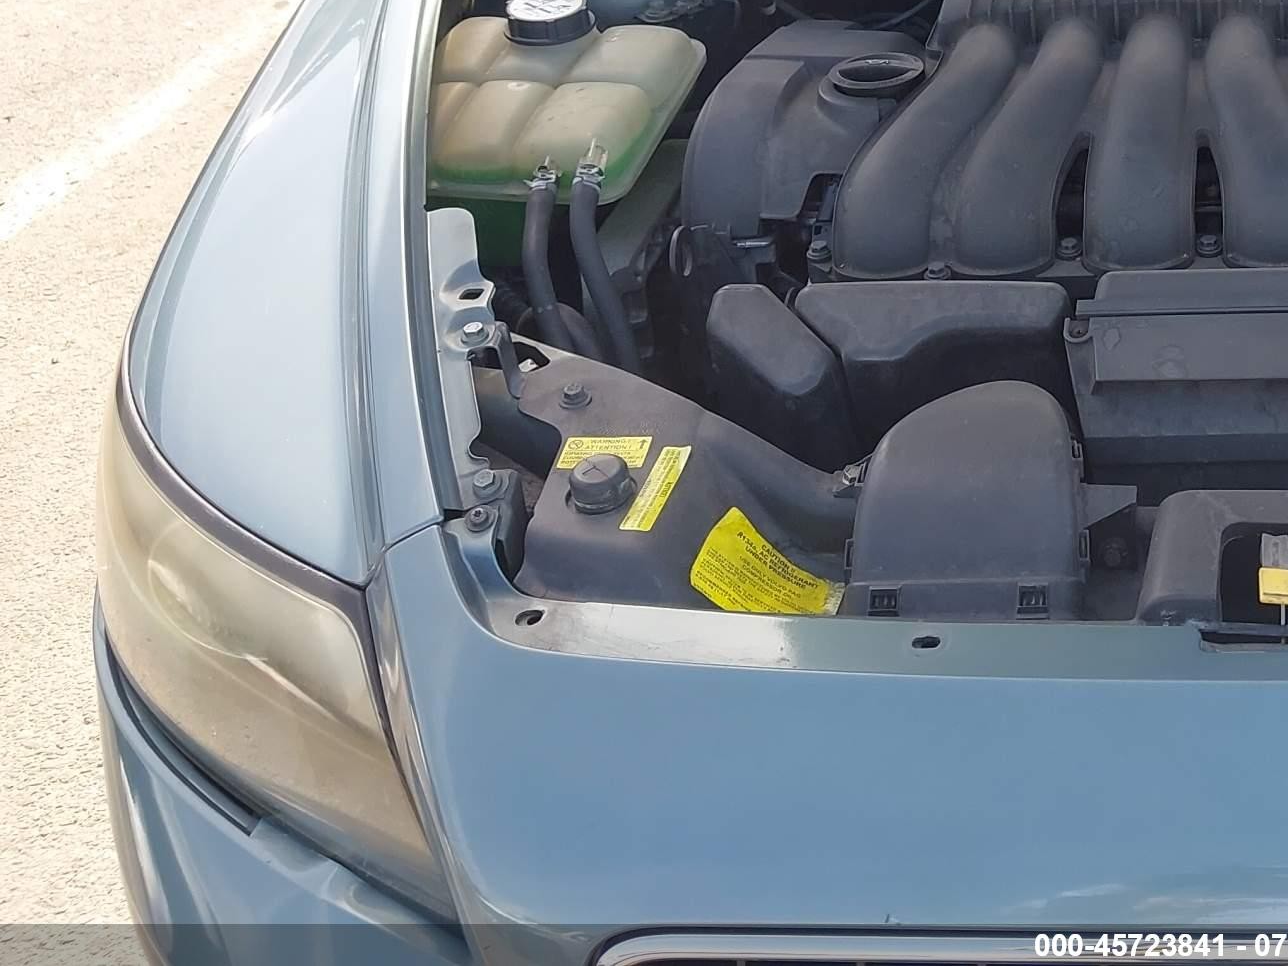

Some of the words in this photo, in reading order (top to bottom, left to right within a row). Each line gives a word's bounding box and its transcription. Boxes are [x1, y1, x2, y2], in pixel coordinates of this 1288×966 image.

[745, 545, 768, 566] UNDER
[768, 564, 806, 589] PRESSURE
[762, 544, 790, 570] CAUTION
